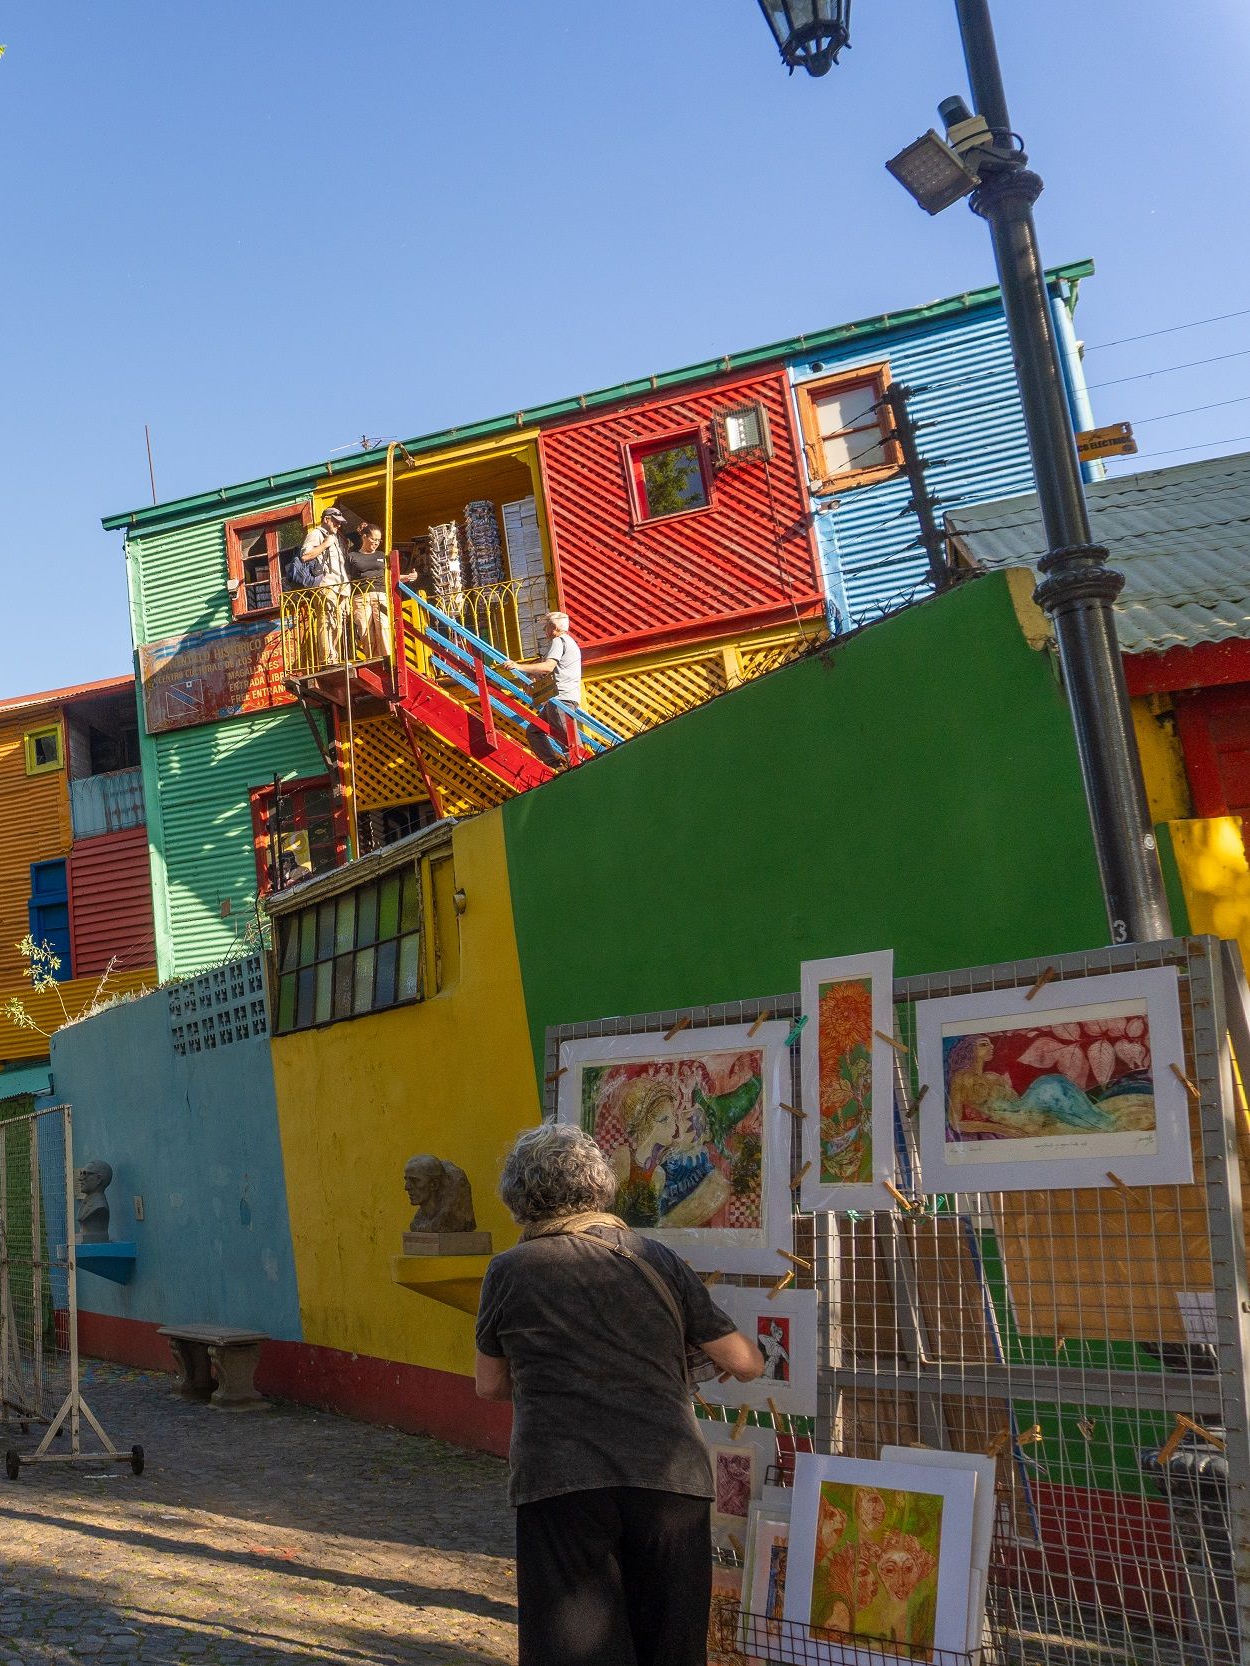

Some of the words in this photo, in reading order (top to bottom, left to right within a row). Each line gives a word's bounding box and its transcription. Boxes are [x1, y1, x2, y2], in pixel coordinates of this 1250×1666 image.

[229, 676, 266, 692] ENTRADA
[231, 693, 251, 704] FREE
[252, 684, 286, 699] ENTRAN
[1113, 920, 1128, 943] 3
